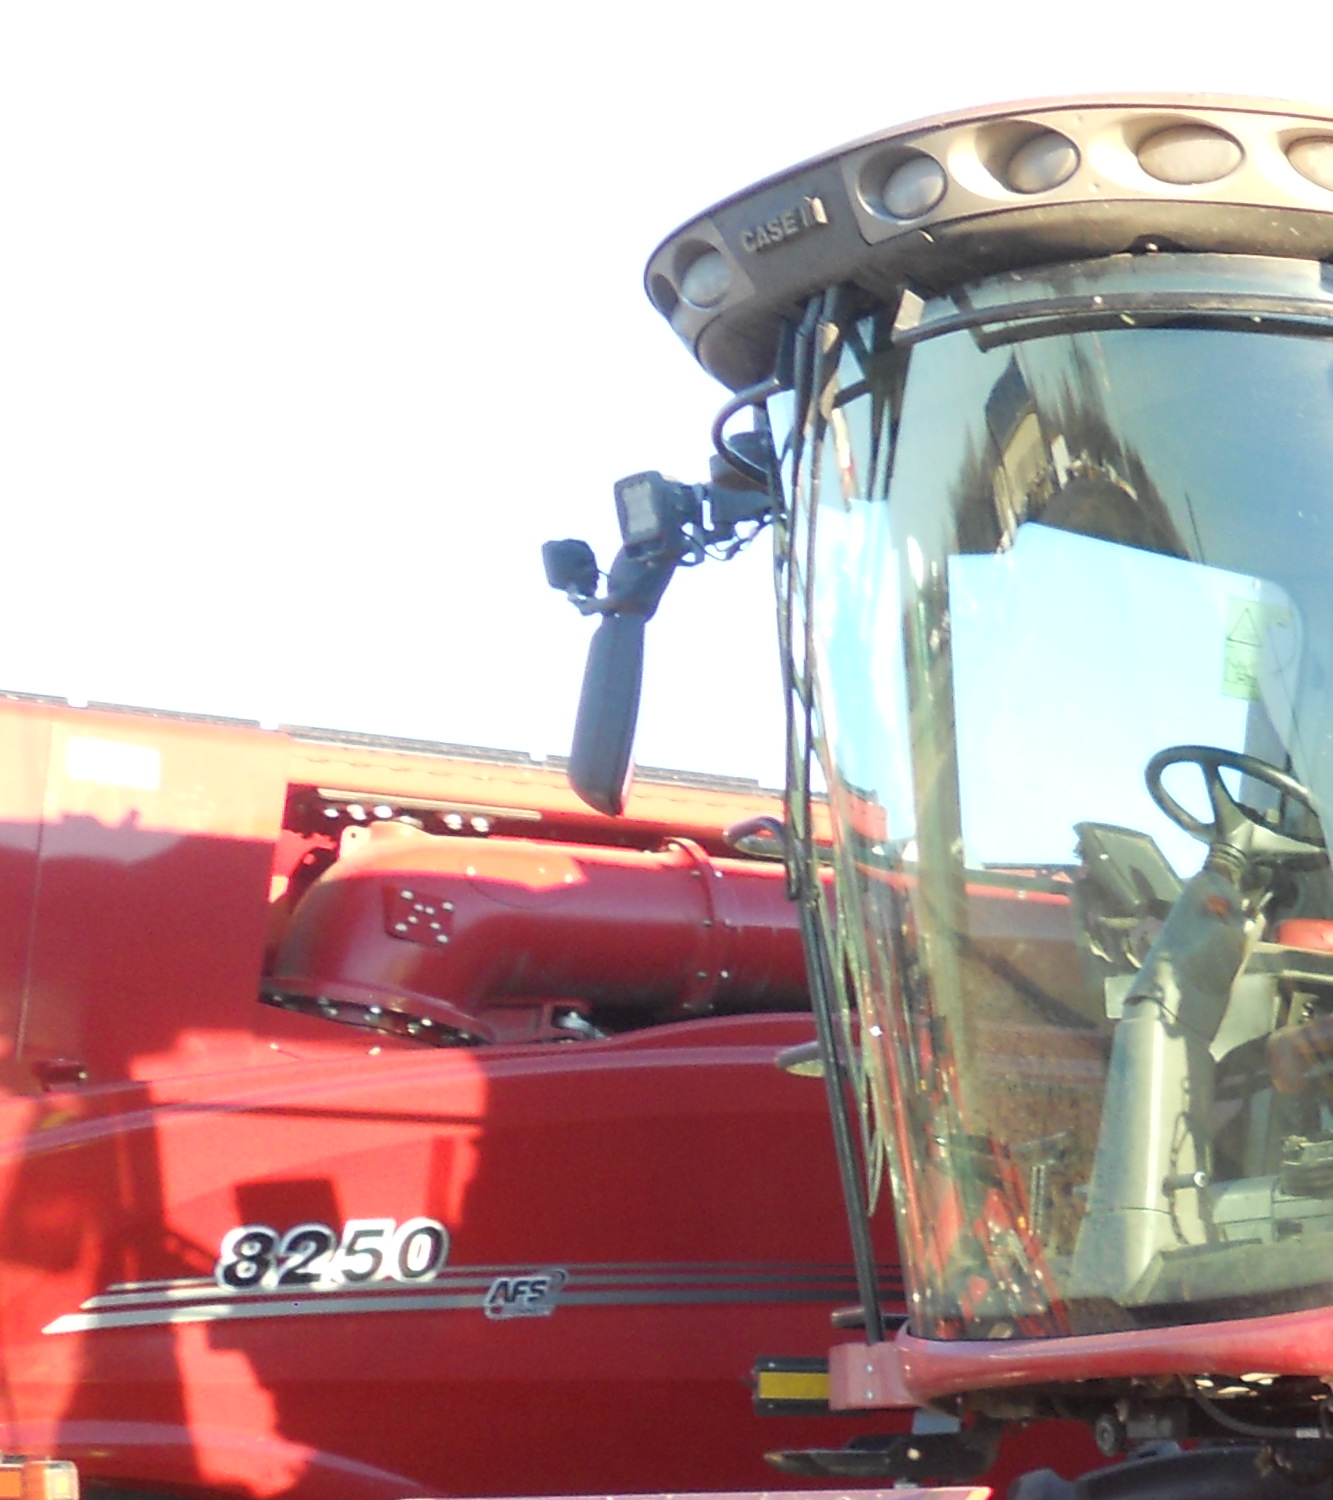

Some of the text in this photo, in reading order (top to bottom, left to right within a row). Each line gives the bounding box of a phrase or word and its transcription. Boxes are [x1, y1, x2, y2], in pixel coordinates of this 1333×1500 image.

[741, 209, 800, 253] CASE
[216, 1218, 450, 1292] 8250
[487, 1277, 550, 1306] AFS
